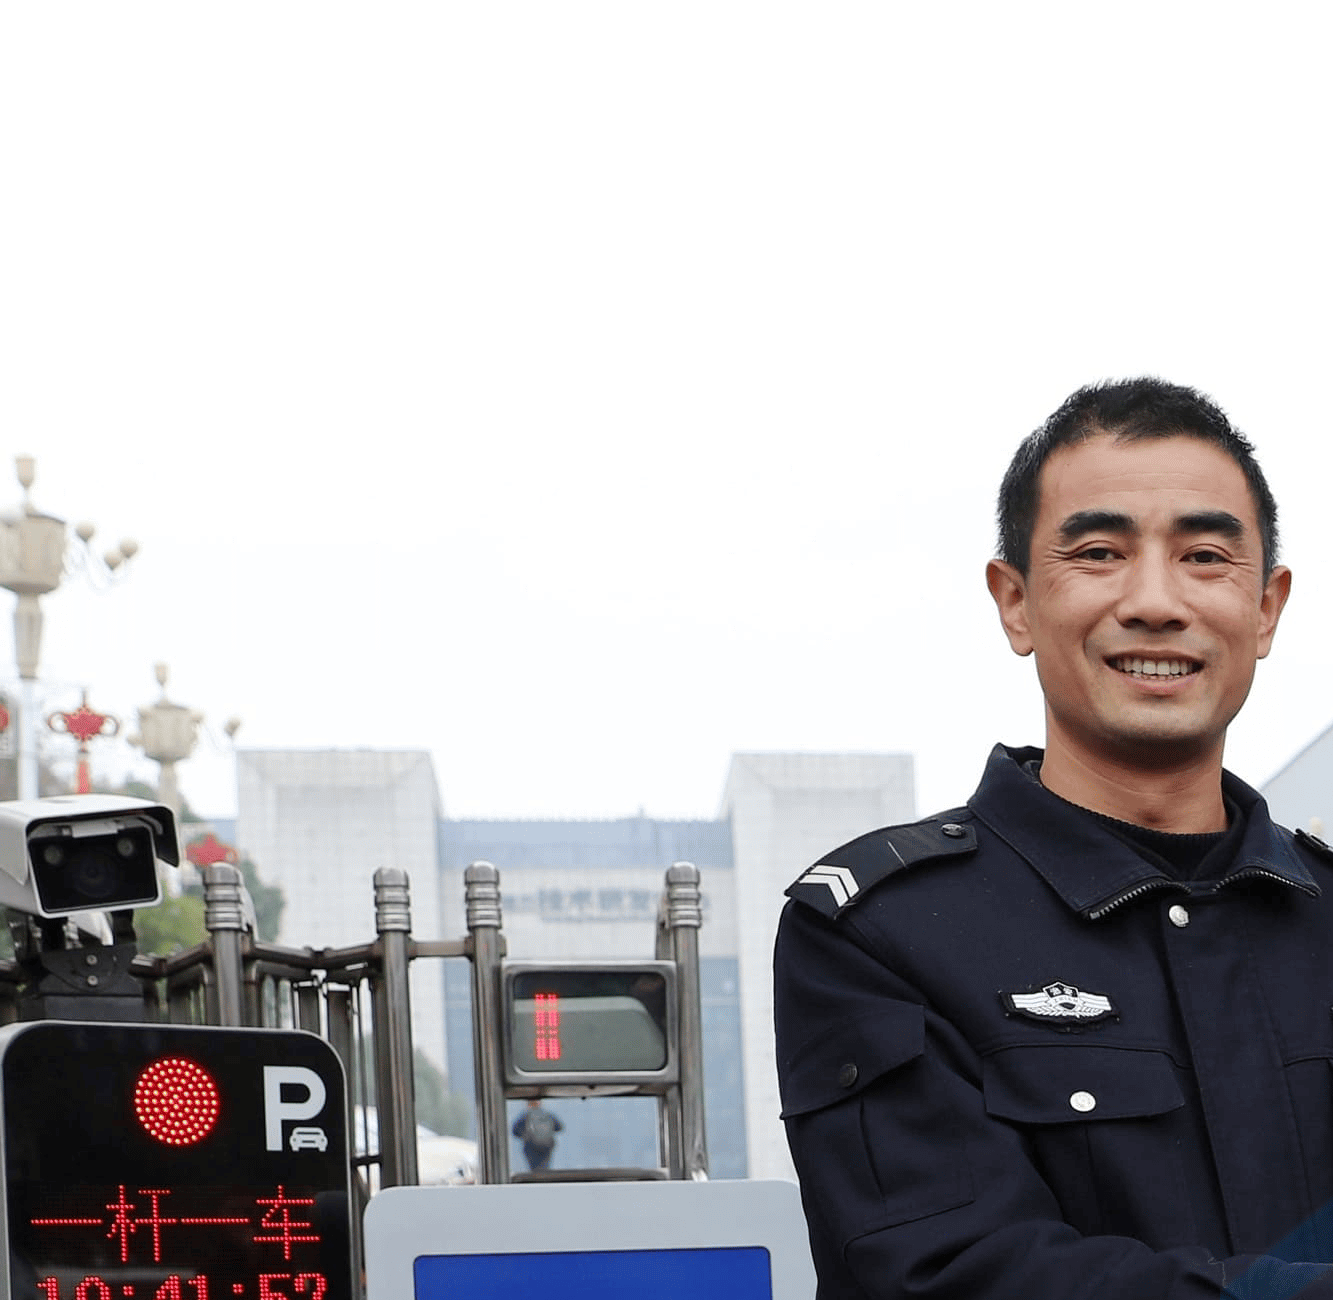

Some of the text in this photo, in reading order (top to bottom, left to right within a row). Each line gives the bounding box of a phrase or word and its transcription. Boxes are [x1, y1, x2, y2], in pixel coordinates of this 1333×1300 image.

[264, 1065, 326, 1151] P
[31, 1185, 320, 1261] 一杆一车
